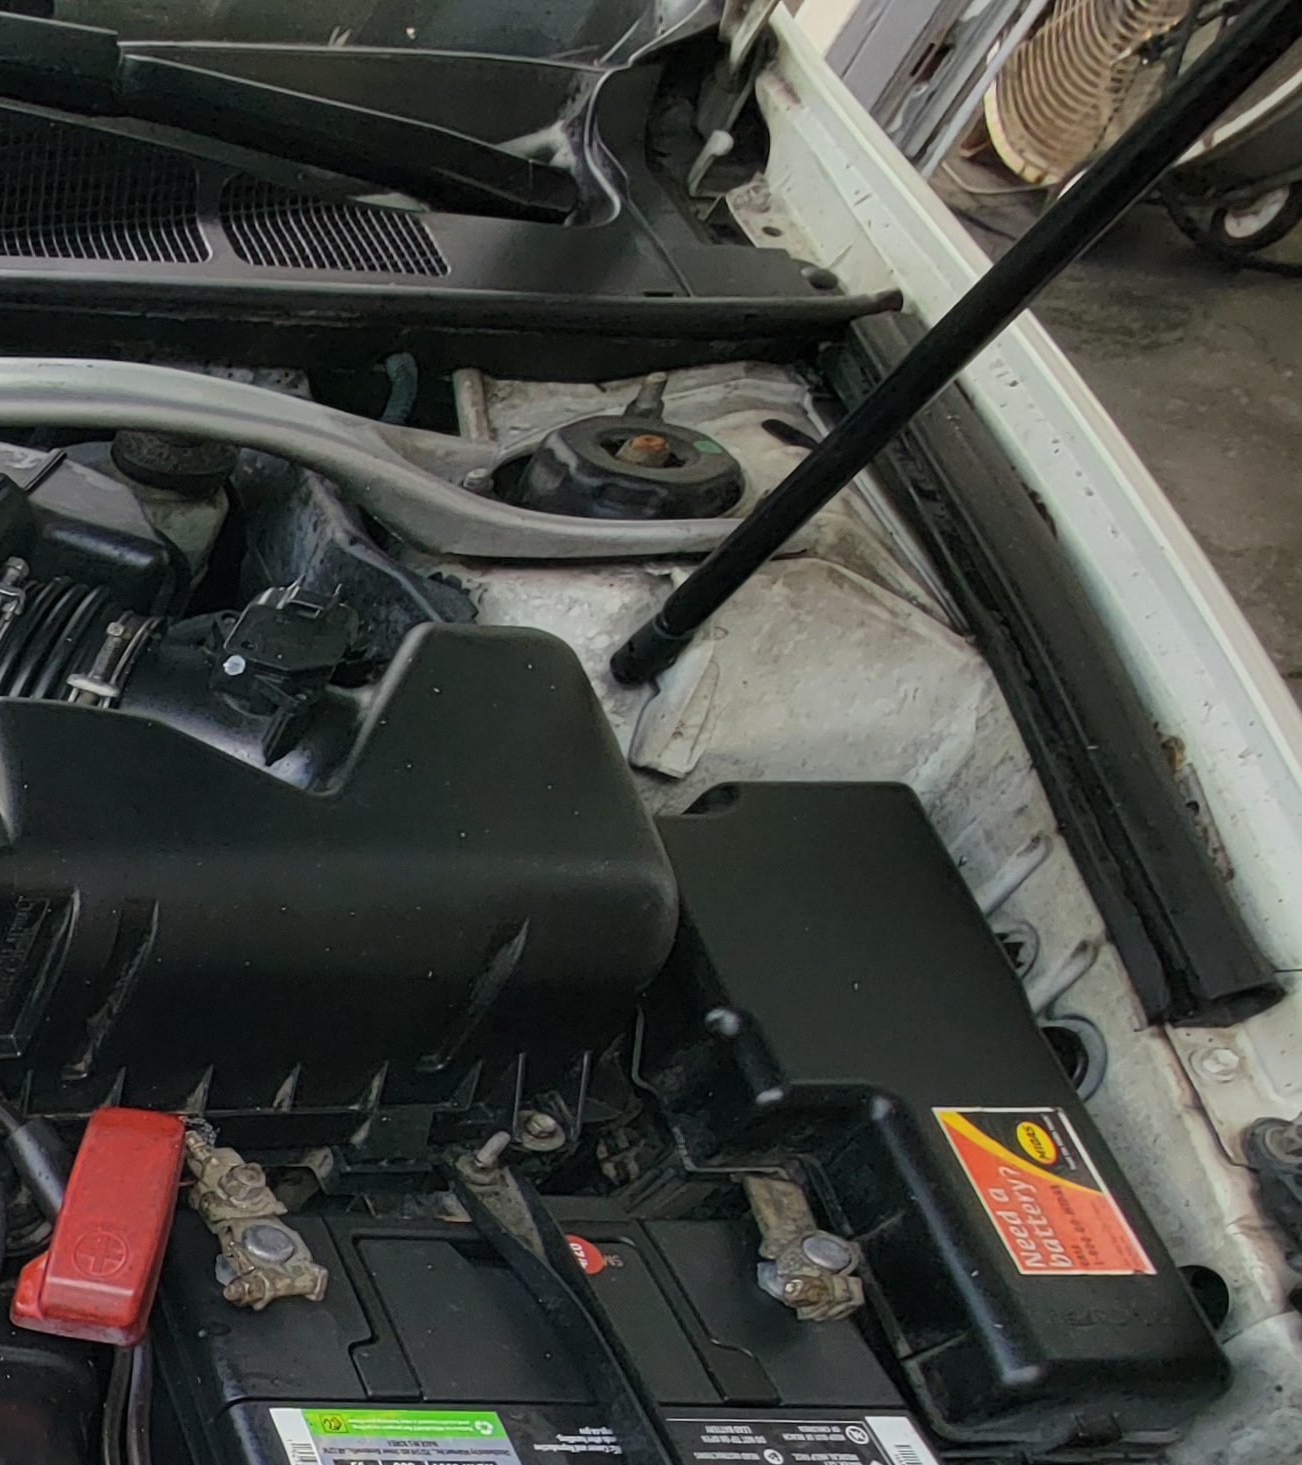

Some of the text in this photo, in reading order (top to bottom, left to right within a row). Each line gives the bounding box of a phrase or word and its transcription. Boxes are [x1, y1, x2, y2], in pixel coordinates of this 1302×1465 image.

[1024, 1127, 1048, 1158] MIDAS
[987, 1188, 1046, 1267] Need a
[996, 1165, 1076, 1267] battery?
